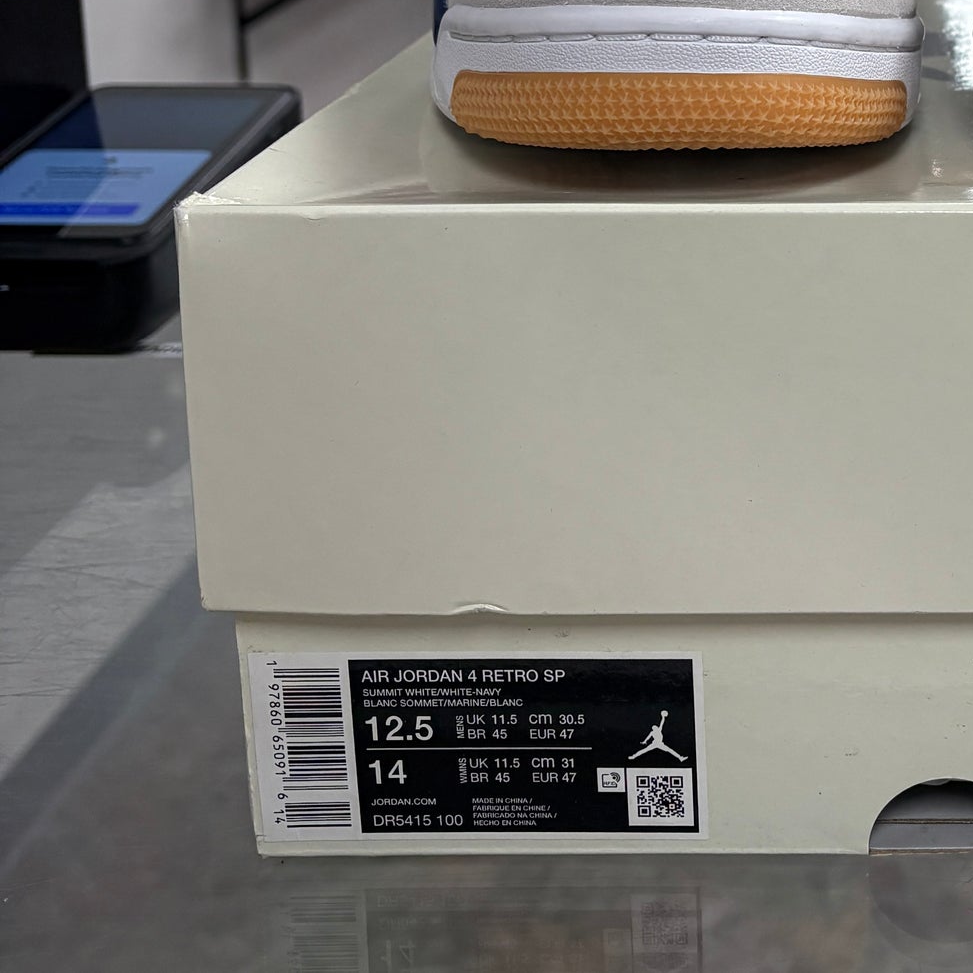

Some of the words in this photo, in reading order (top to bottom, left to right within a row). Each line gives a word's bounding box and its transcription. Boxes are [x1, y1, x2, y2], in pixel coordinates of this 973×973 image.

[361, 669, 390, 683] AIR
[393, 669, 463, 683] JORDAN
[467, 669, 478, 683] 4
[482, 669, 539, 683] RETRO
[543, 669, 566, 683] SP
[362, 688, 403, 697] SUMMIT
[404, 688, 502, 697] WHITE/WHITE-NAVY
[268, 683, 284, 726] 97860
[363, 699, 398, 708] BLANC
[399, 698, 523, 707] SOMMET/MARINE/BLANC
[466, 714, 486, 725] UK
[491, 714, 518, 725] 11.5
[528, 713, 553, 725] cm
[559, 714, 585, 725] 30.5
[364, 715, 434, 741] 12.5
[455, 715, 465, 739] MENS
[467, 728, 486, 739] BR
[492, 728, 508, 740] 45
[529, 728, 556, 740] EUR
[559, 728, 575, 740] 47
[272, 735, 288, 775] 65091
[469, 758, 489, 769] UK
[494, 757, 521, 769] 11.5
[531, 757, 555, 768] cm
[561, 757, 574, 769] 31
[368, 759, 408, 785] 14
[458, 757, 468, 784] WMNS
[470, 772, 489, 783] BR
[495, 772, 510, 783] 45
[532, 772, 559, 783] EUR
[561, 772, 577, 783] 47
[277, 792, 289, 800] 6
[371, 797, 437, 806] JORDAN.COM
[273, 809, 287, 824] 14
[373, 814, 432, 827] DR5415
[436, 814, 463, 826] 100
